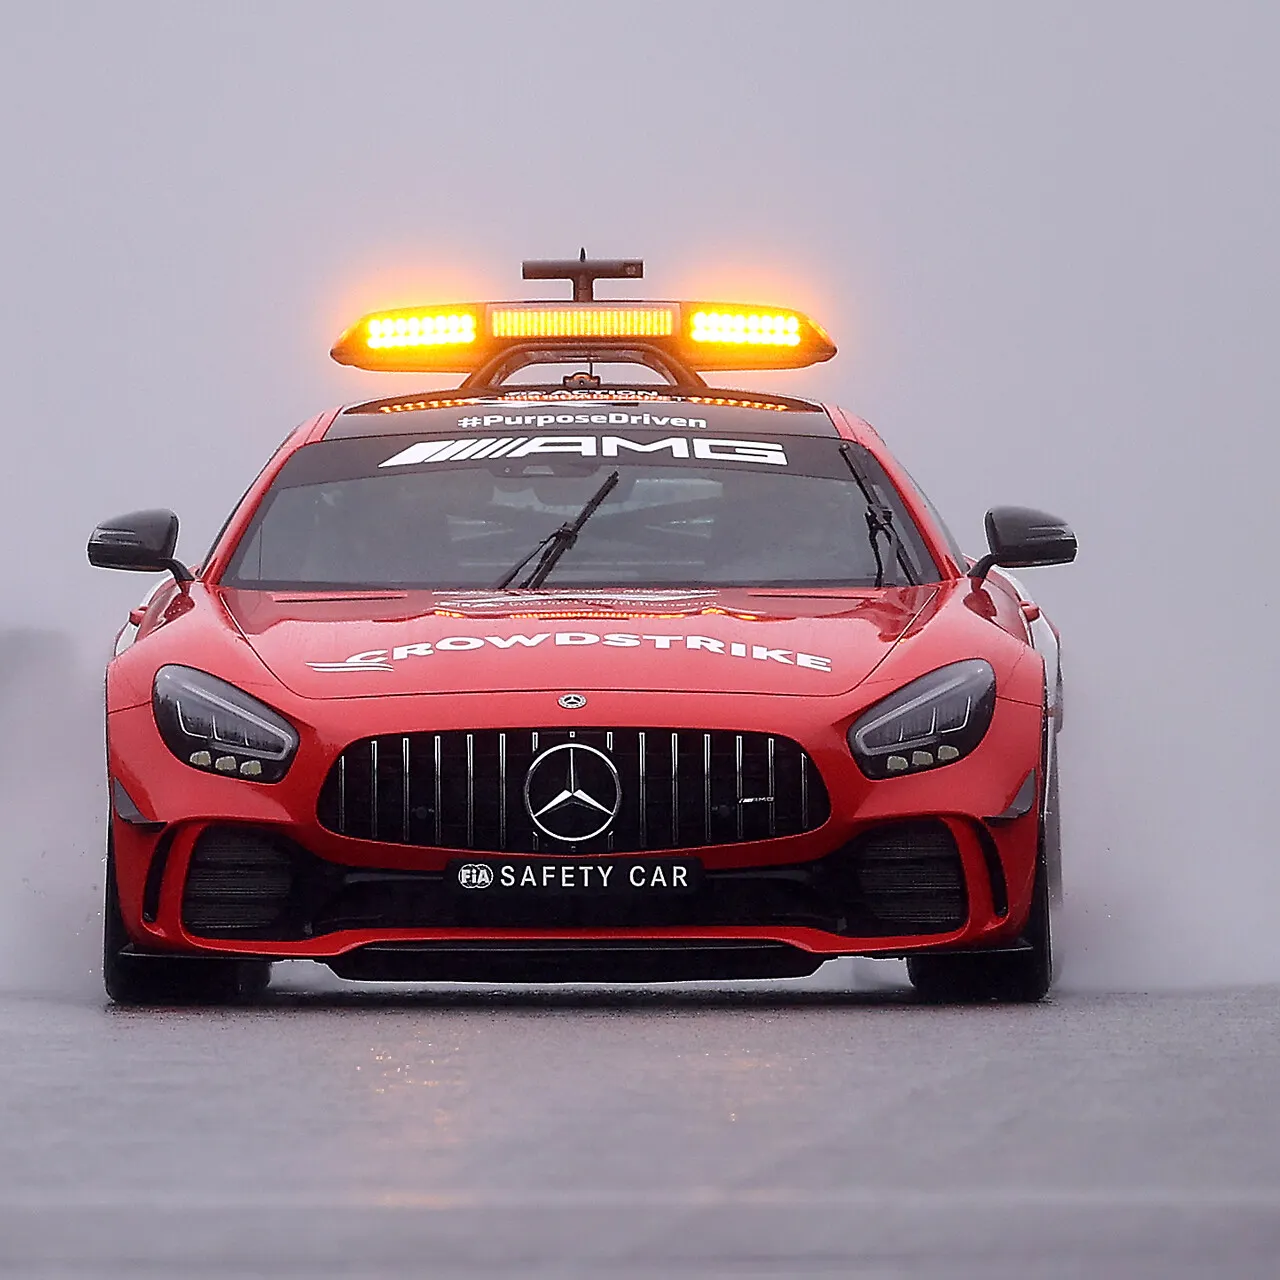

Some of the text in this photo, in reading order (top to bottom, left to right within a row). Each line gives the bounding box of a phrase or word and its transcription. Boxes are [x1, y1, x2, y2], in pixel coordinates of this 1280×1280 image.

[457, 412, 707, 429] #PurposeDriven
[506, 436, 788, 464] AMG
[332, 632, 833, 672] CROWDSTRIKE
[500, 866, 613, 887] SAFETY
[629, 866, 688, 887] CAR
